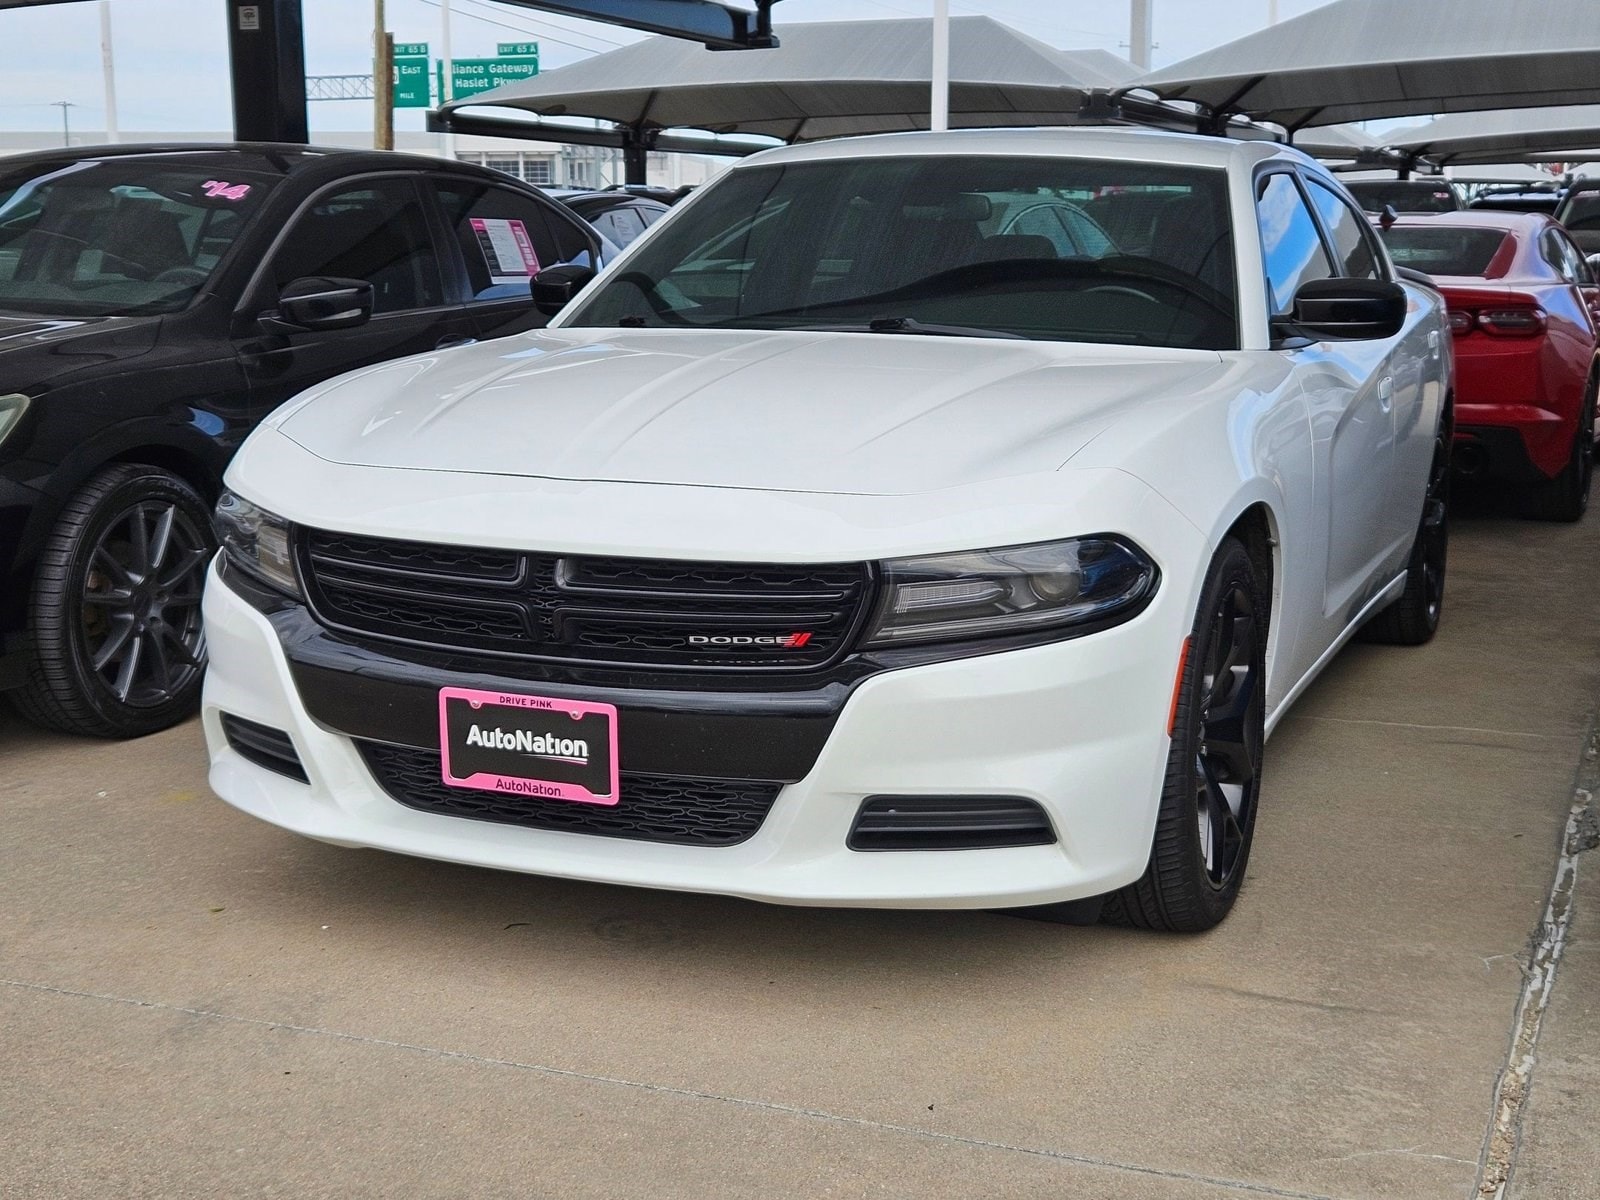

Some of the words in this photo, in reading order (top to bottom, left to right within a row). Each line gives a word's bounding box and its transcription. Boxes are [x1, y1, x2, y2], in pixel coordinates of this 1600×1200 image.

[408, 45, 419, 54] 65
[420, 45, 427, 53] B
[517, 45, 528, 54] 65
[530, 44, 537, 53] A
[401, 65, 421, 74] EAST
[452, 64, 484, 74] liance
[489, 64, 534, 75] Gateway
[455, 78, 488, 88] Haslet
[688, 635, 796, 645] DODGE
[499, 695, 527, 706] DRIVE
[530, 699, 553, 709] PINK
[466, 724, 588, 758] AutoNation
[495, 778, 563, 797] AutoNation
